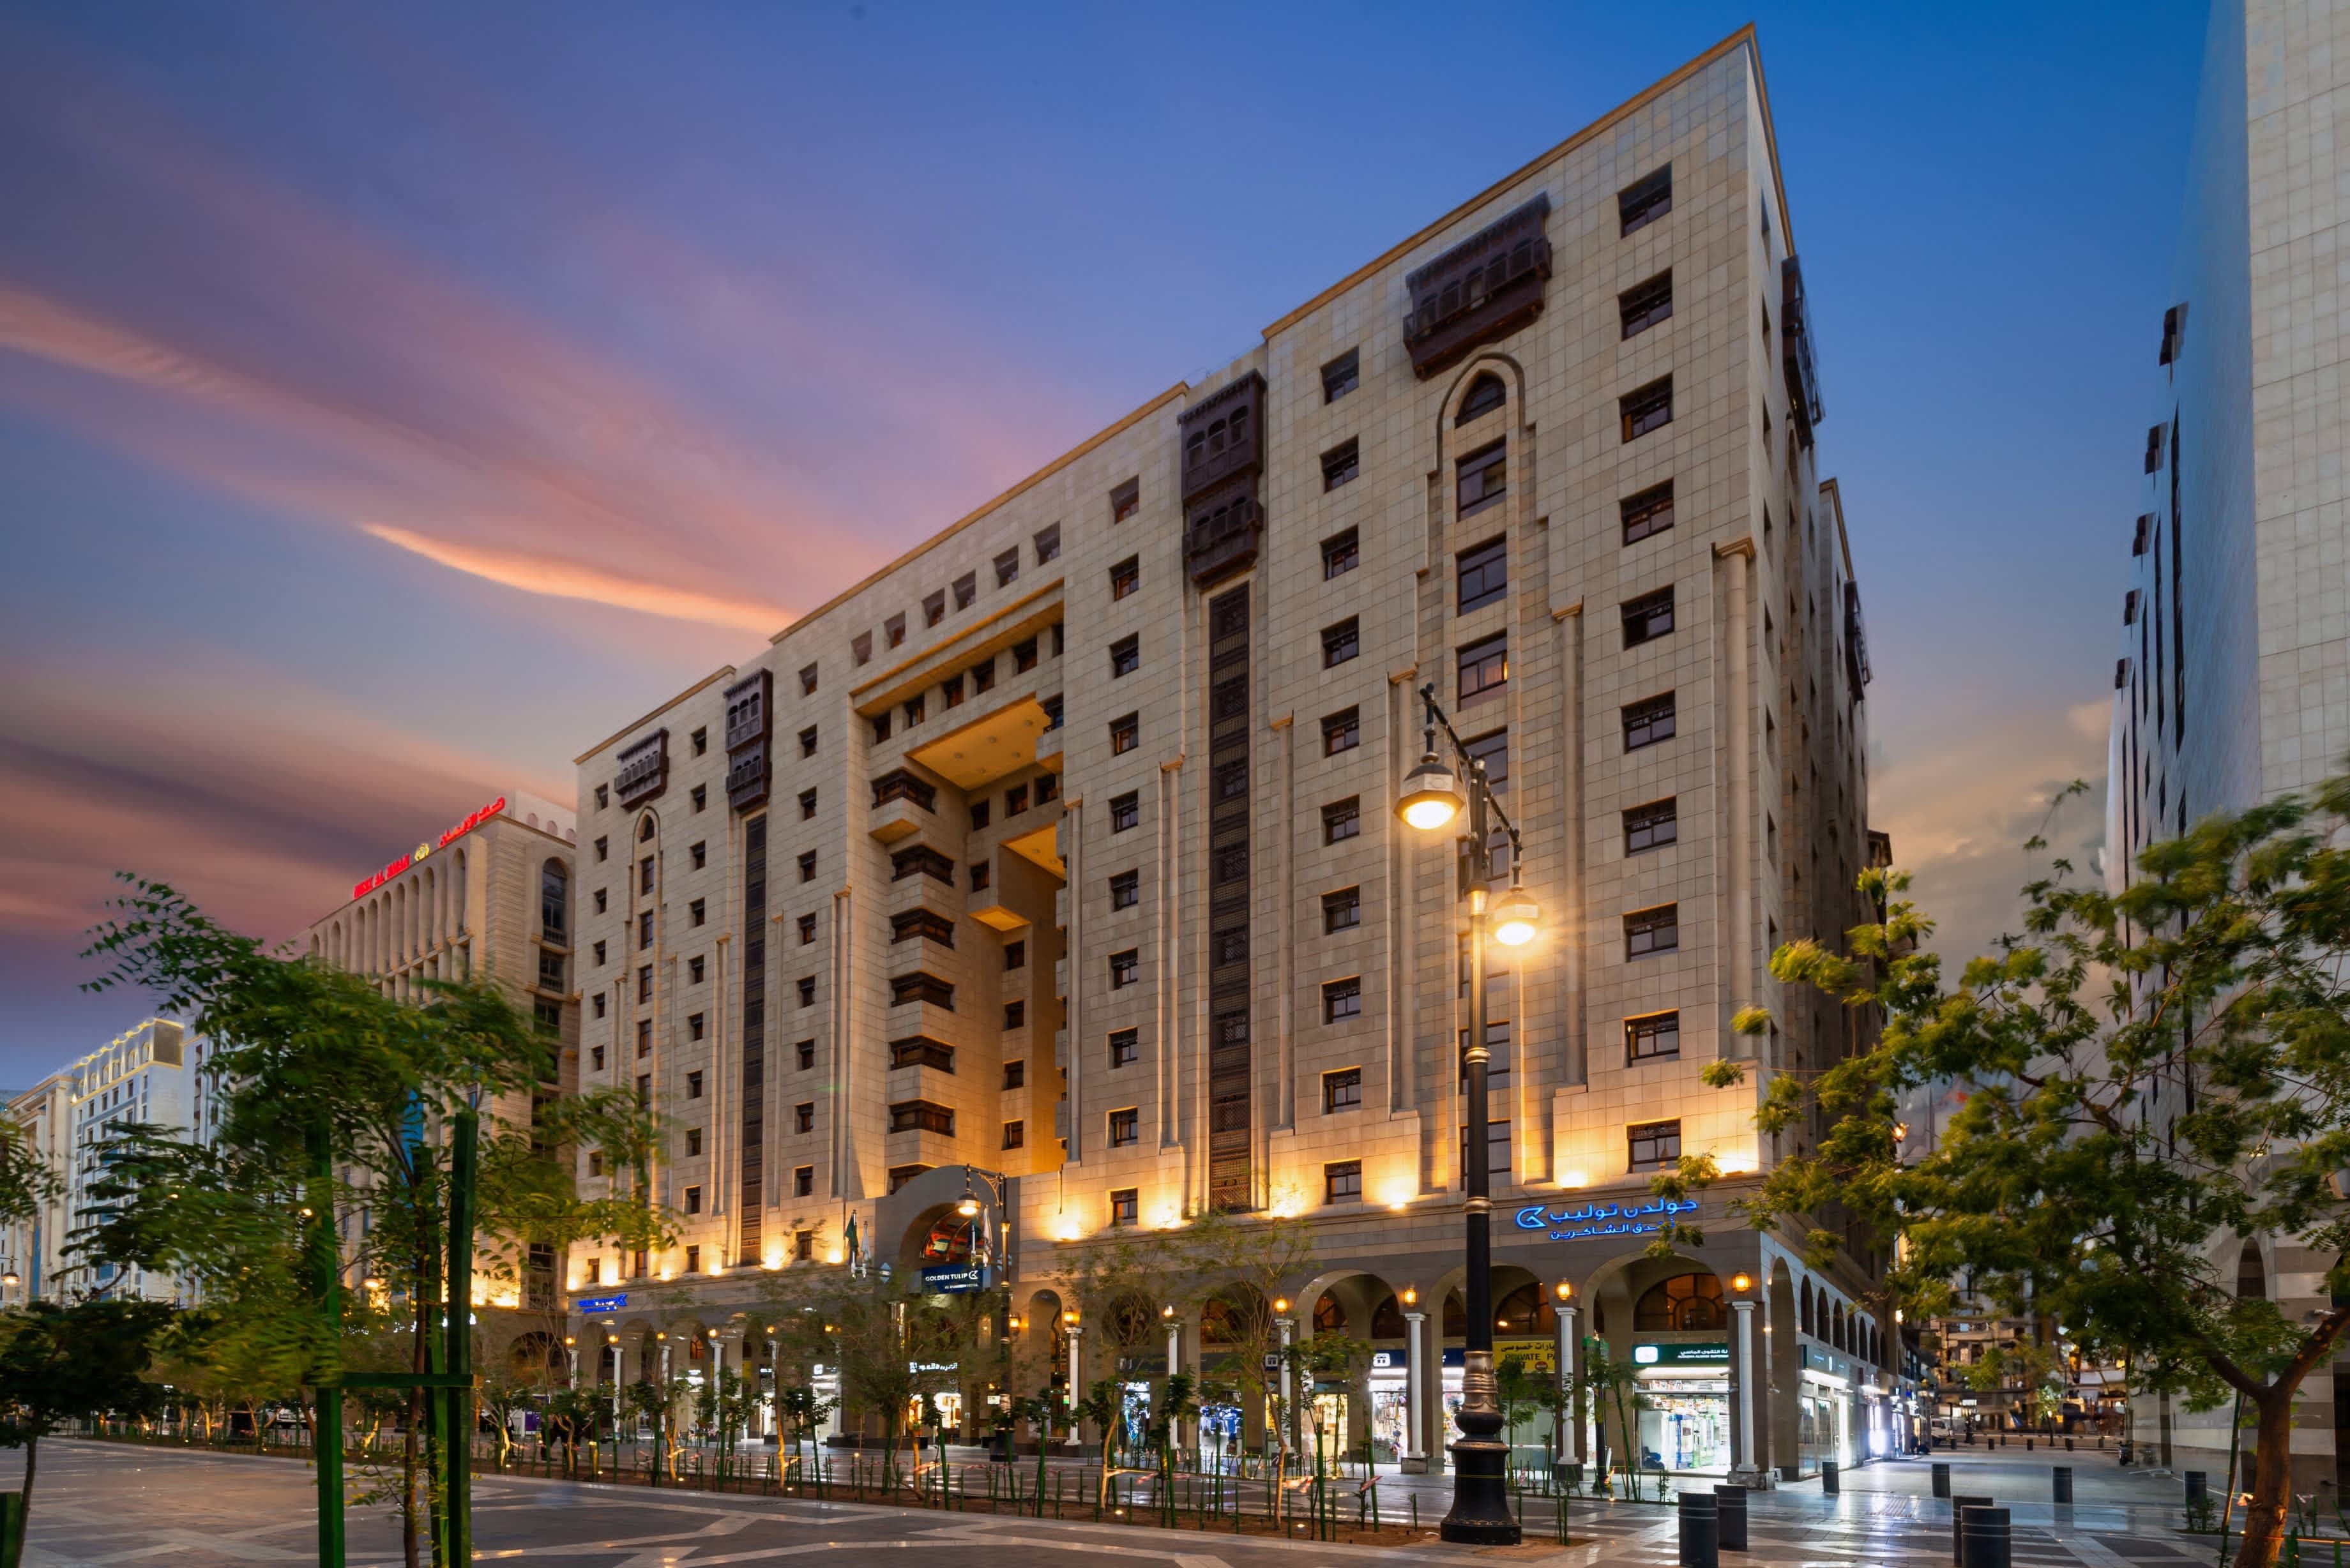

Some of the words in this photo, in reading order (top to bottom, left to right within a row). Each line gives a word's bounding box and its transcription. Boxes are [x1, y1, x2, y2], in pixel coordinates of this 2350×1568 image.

[1549, 1203, 1619, 1222] توليب
[1623, 1197, 1698, 1218] جولدن
[1550, 1223, 1629, 1240] الشاكرين
